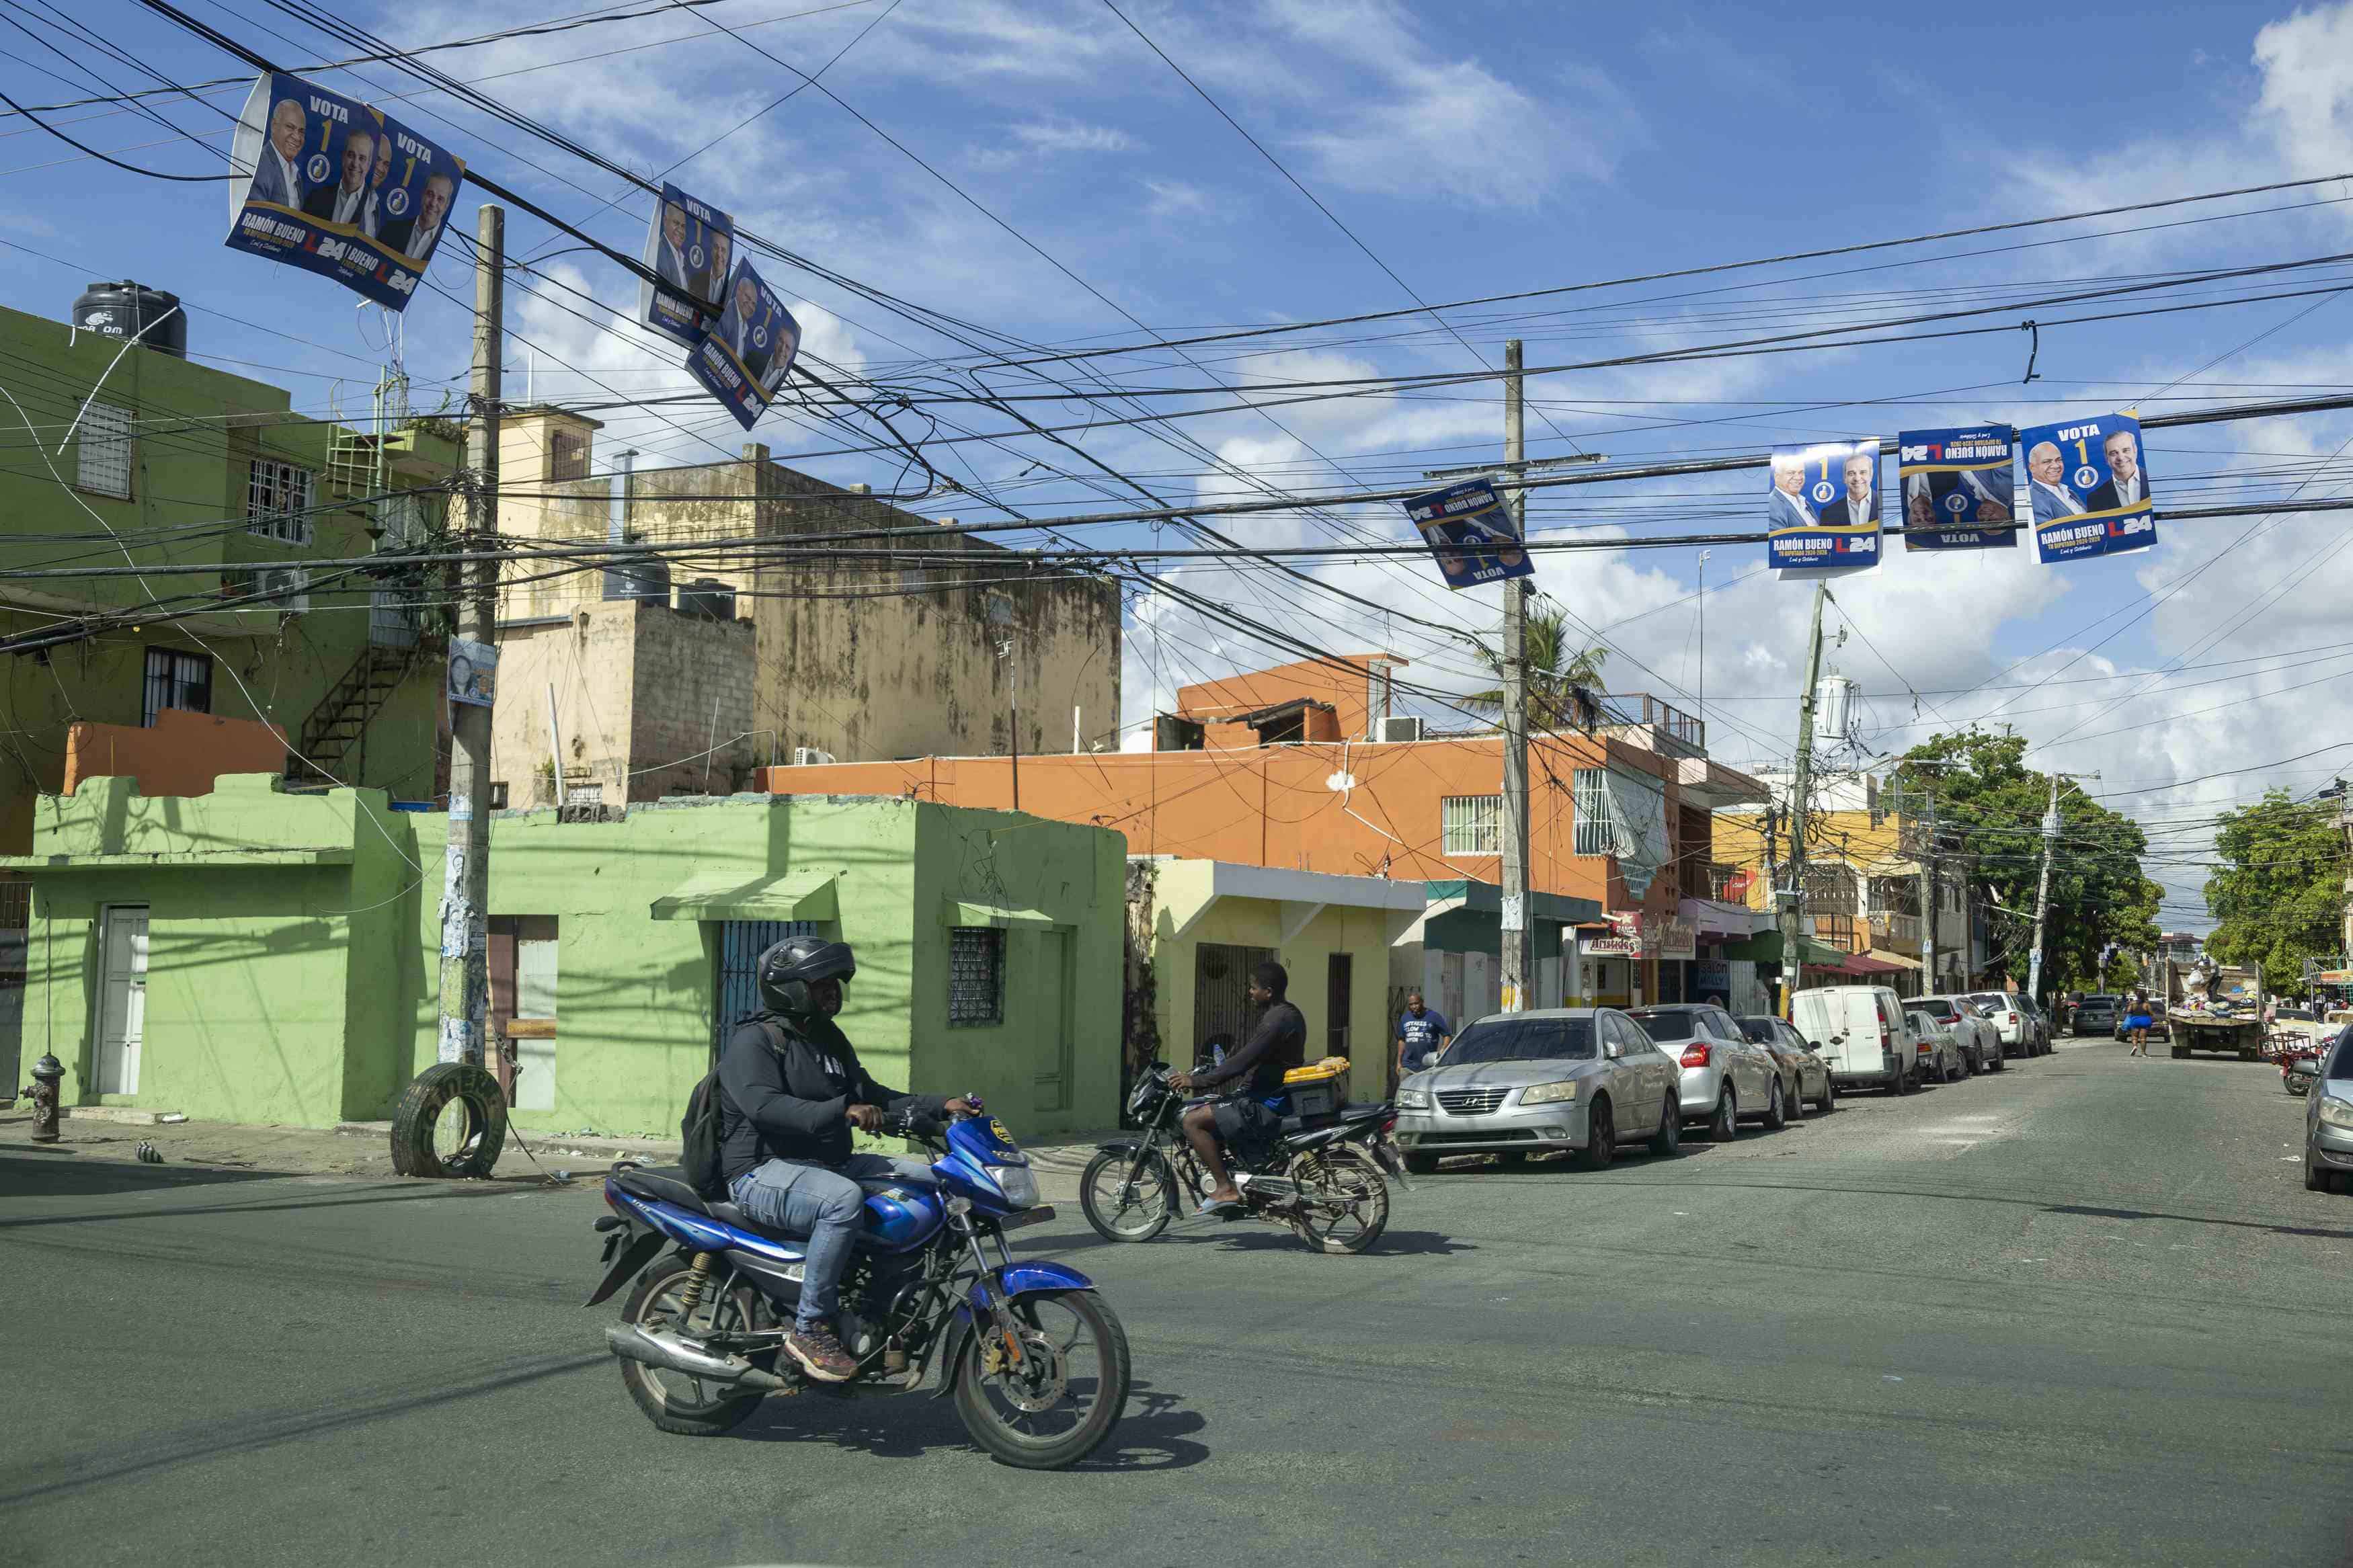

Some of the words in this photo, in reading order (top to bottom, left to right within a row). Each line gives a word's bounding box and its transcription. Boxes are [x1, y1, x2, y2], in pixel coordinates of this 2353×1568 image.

[310, 95, 348, 124] VOTA
[321, 119, 332, 152] 1
[398, 132, 431, 164] VOTA
[402, 157, 416, 187] 1
[686, 199, 711, 222] VOTA
[241, 213, 276, 233] RAMÓN
[274, 222, 306, 243] BUENO
[348, 248, 378, 271] BUENO
[655, 292, 676, 311] RAMÓN
[675, 301, 694, 319] BUENO
[760, 286, 782, 317] VOTA
[703, 342, 726, 370] RAMÓN
[721, 364, 742, 388] BUENO
[2057, 424, 2100, 441] VOTA
[1945, 446, 1973, 459] BUENO
[1976, 444, 2007, 459] RAMÓN
[2075, 439, 2088, 464] 1
[1819, 456, 1828, 480] 1
[1444, 498, 1468, 513] BUENO
[1468, 492, 1494, 507] RAMÓN
[1773, 538, 1803, 551] RAMÓN
[1805, 538, 1832, 550] BUENO
[1940, 534, 1979, 543] VOTA
[2040, 528, 2073, 544] RAMÓN
[2074, 524, 2105, 540] BUENO
[1472, 566, 1505, 580] VOTA
